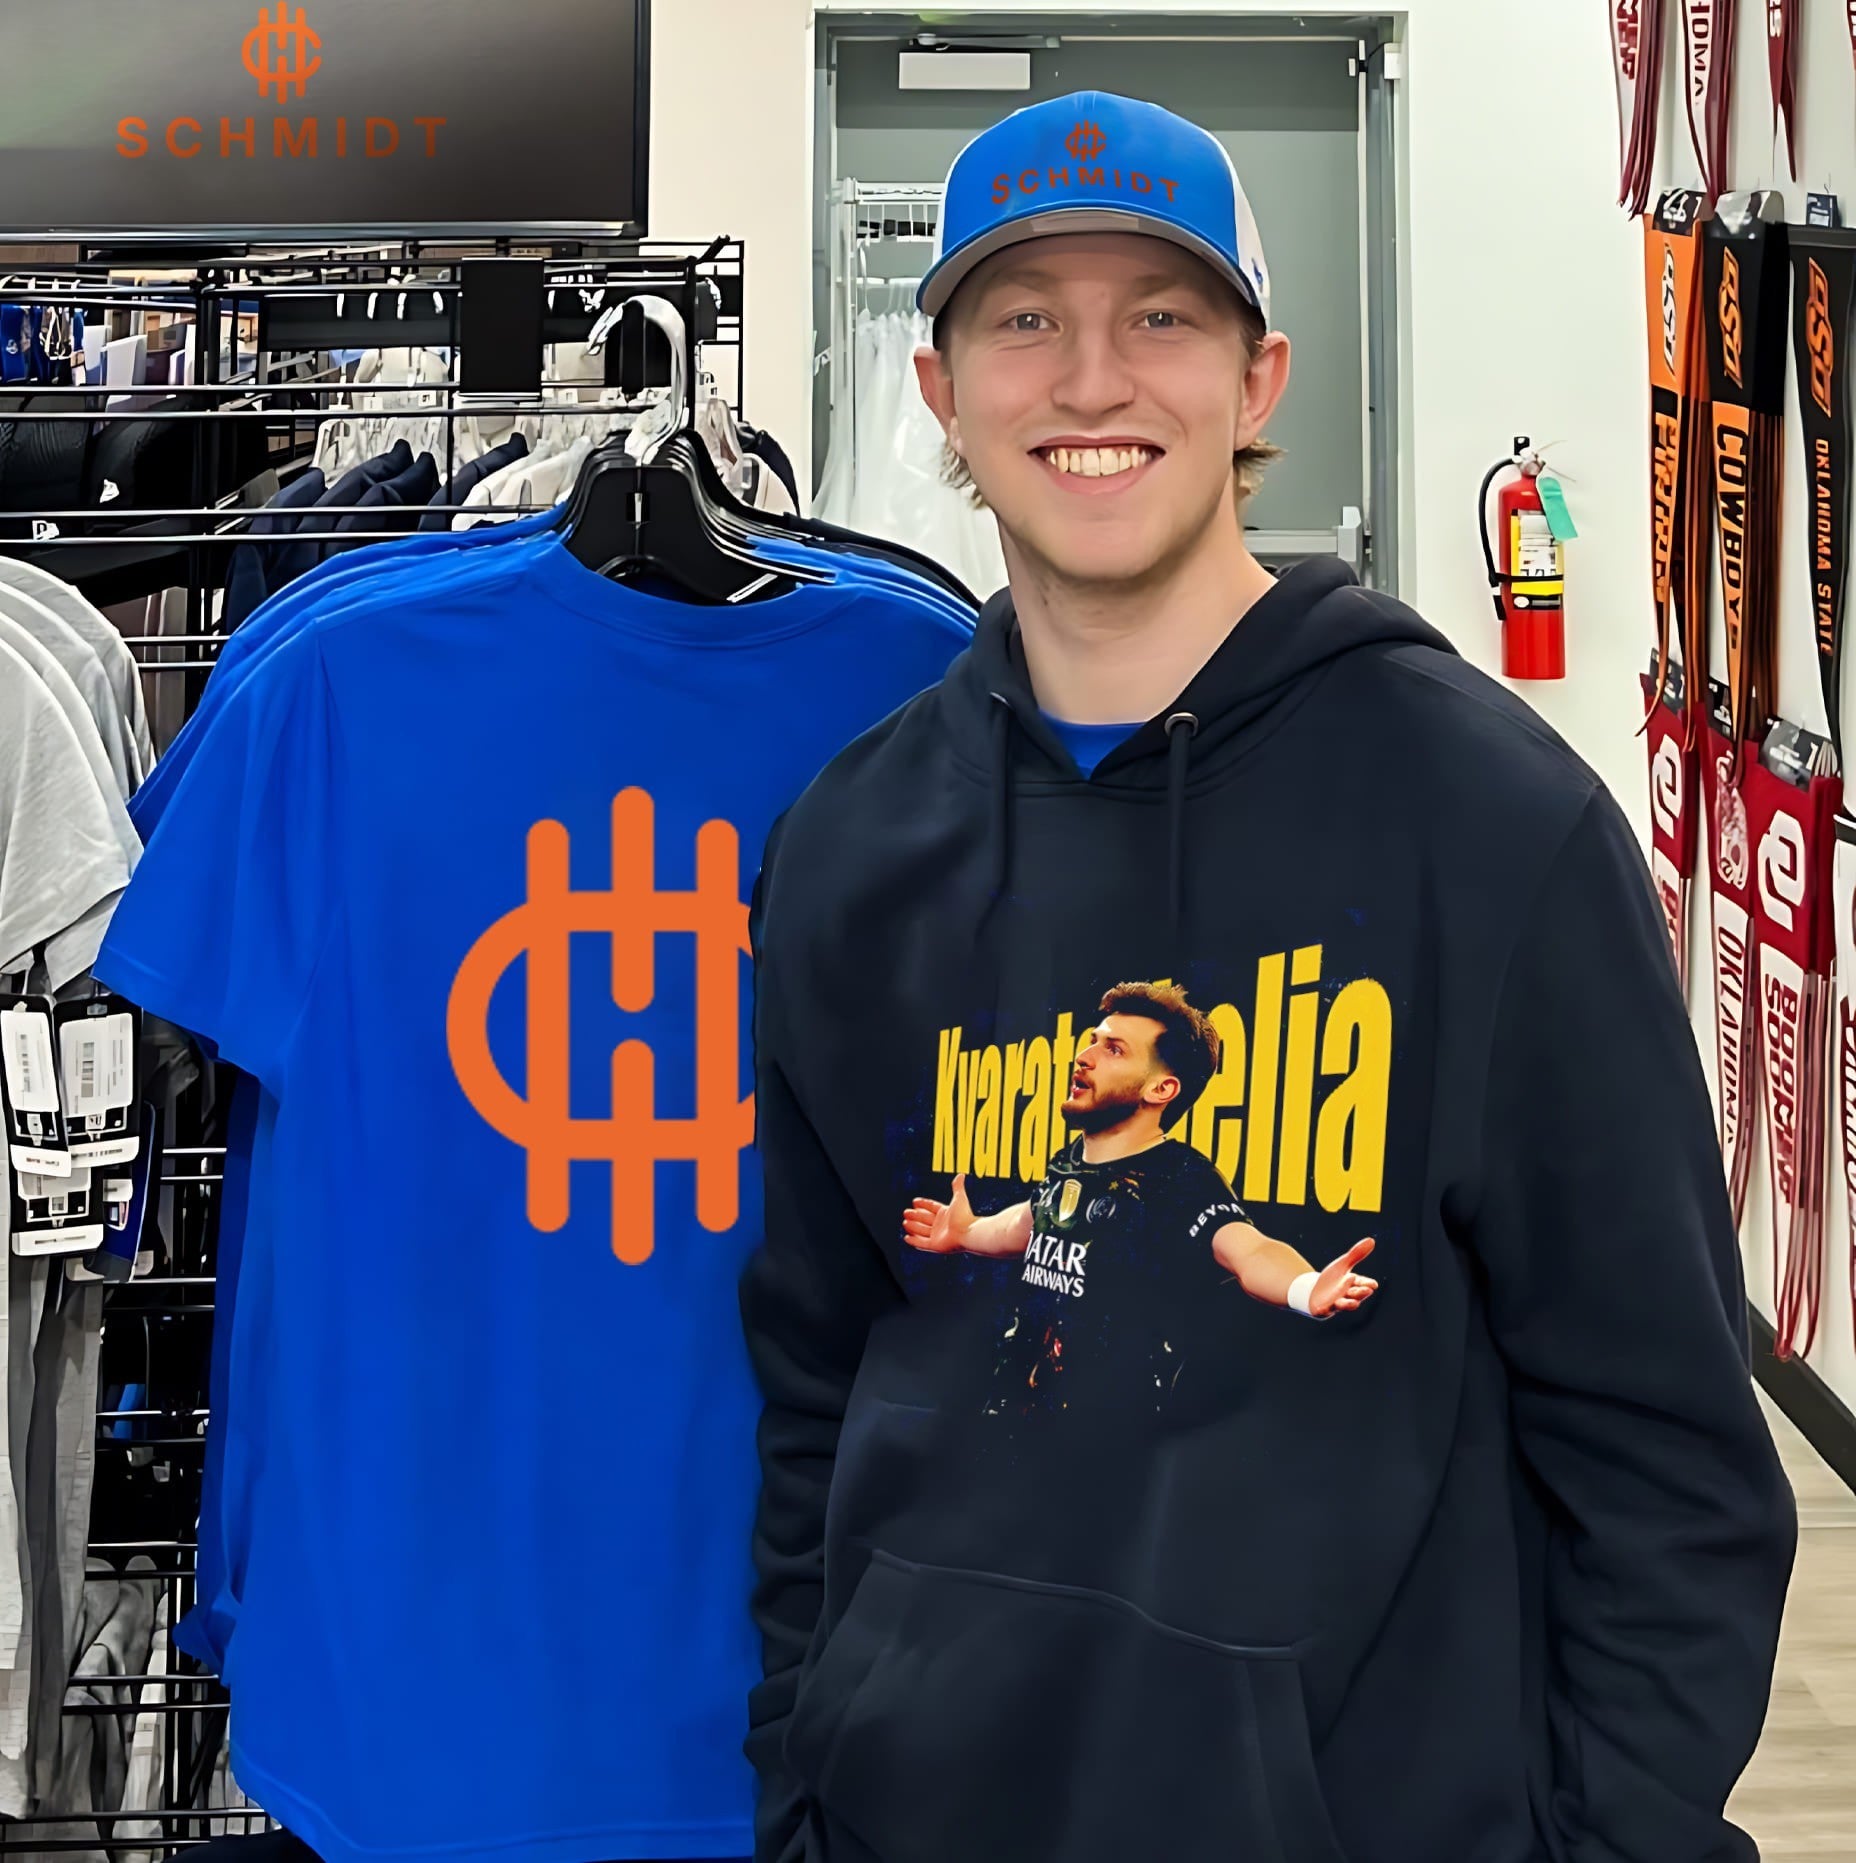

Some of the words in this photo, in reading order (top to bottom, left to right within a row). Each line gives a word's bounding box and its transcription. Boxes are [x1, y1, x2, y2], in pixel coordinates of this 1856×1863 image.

[115, 116, 448, 159] SCHMIDT
[991, 166, 1180, 205] SCHMIDT
[1815, 438, 1832, 571] OKLAHOMA
[1021, 1263, 1085, 1298] AIRWAYS
